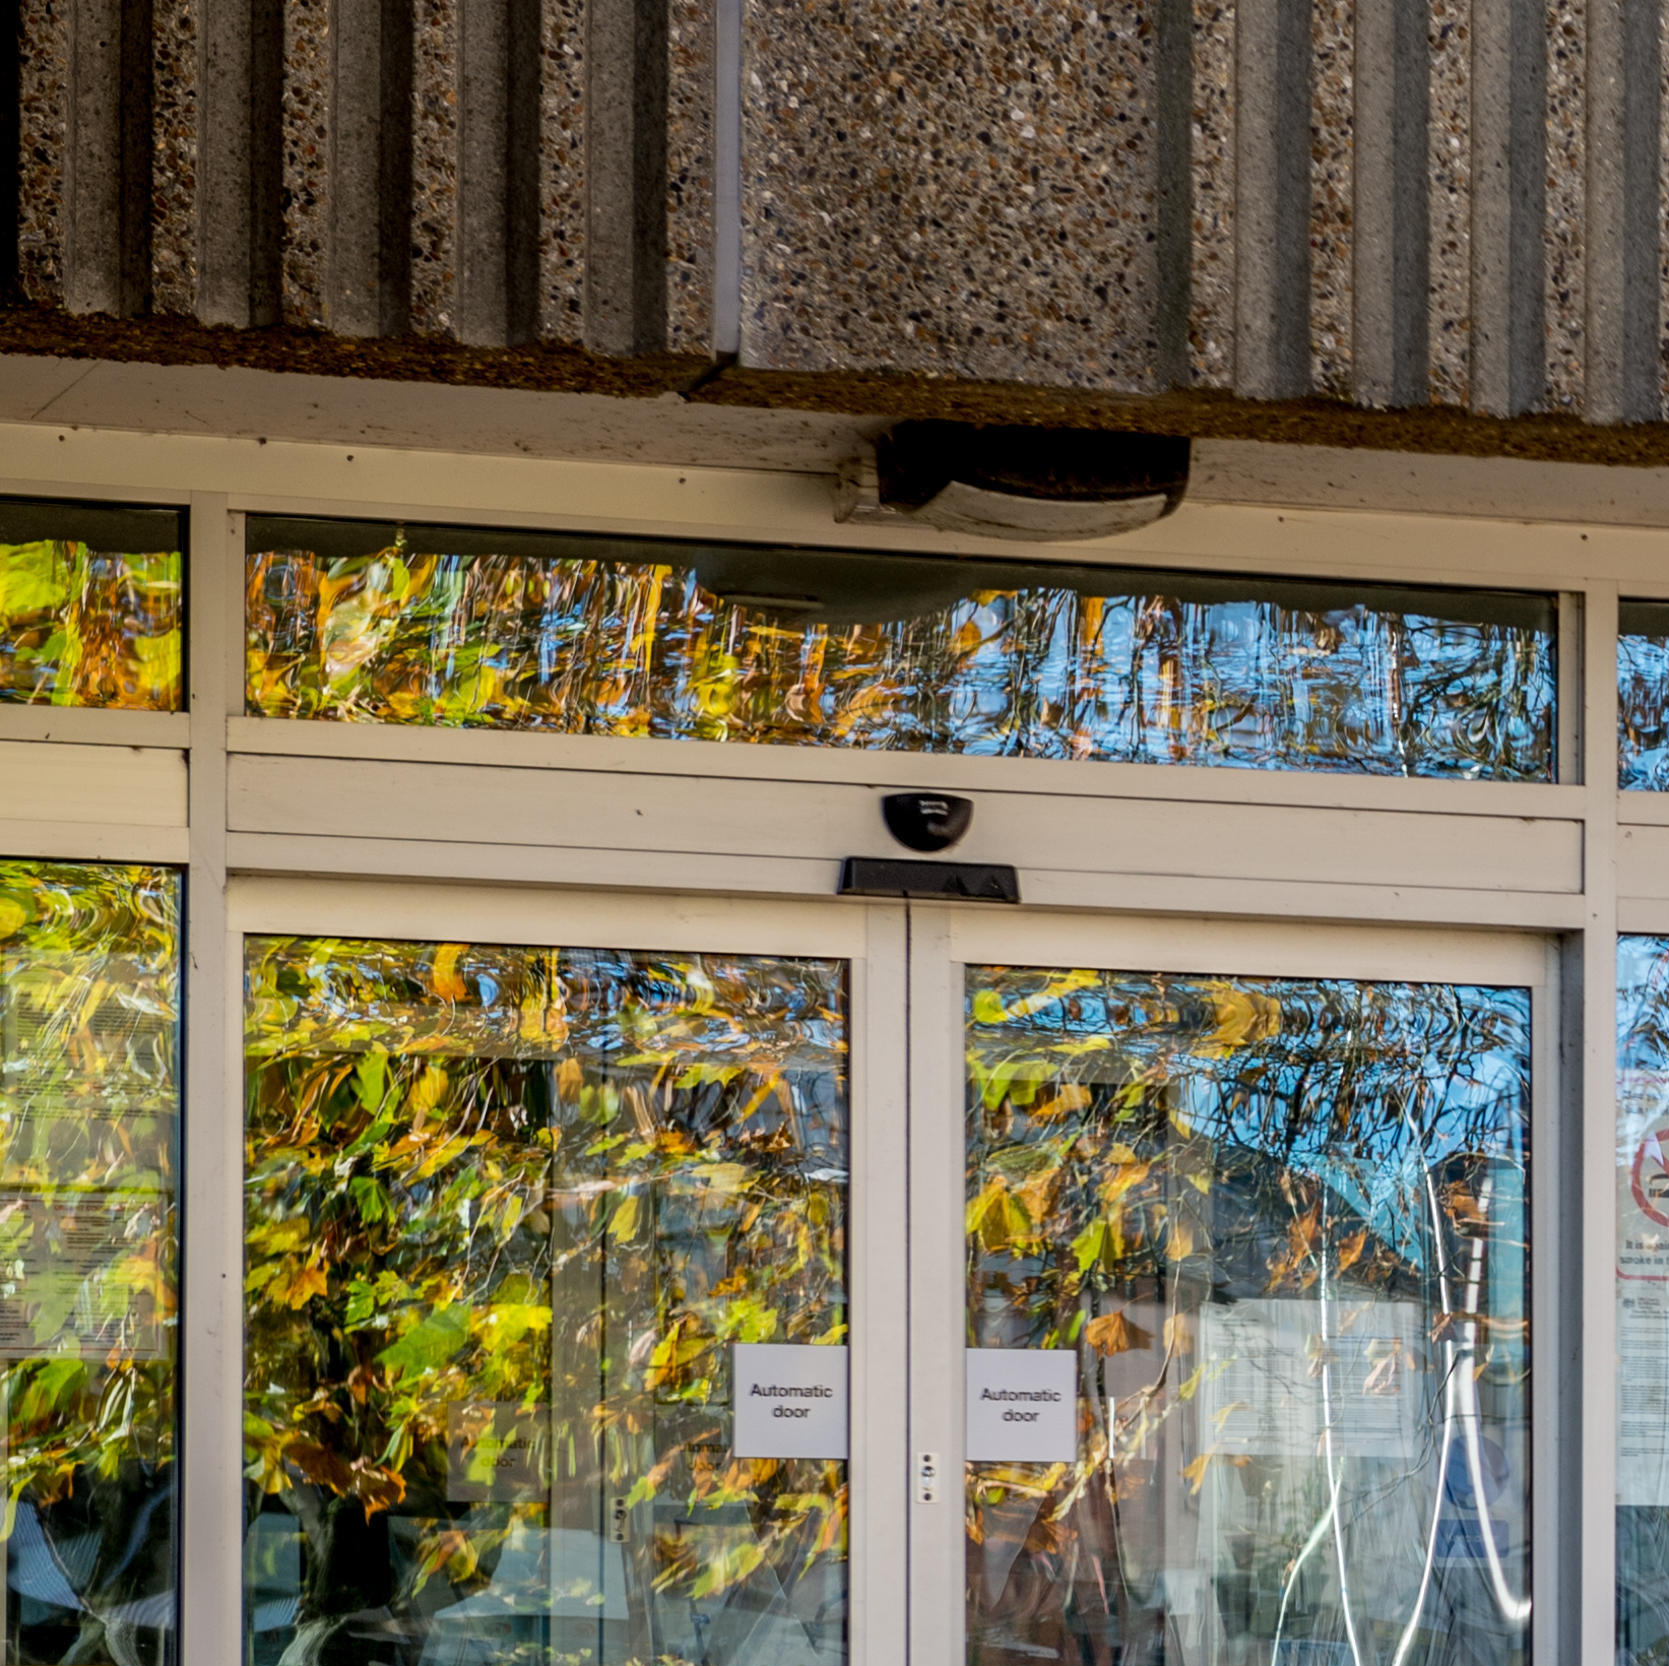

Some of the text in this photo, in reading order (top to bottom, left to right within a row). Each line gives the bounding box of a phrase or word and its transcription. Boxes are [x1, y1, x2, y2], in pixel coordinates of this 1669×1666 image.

[1625, 1240, 1633, 1249] It
[1635, 1240, 1643, 1250] is
[1619, 1255, 1651, 1265] smoke
[1654, 1255, 1664, 1265] in
[750, 1383, 833, 1398] Automatic
[981, 1387, 1062, 1402] Automatic
[773, 1405, 811, 1418] door
[1002, 1408, 1040, 1422] door
